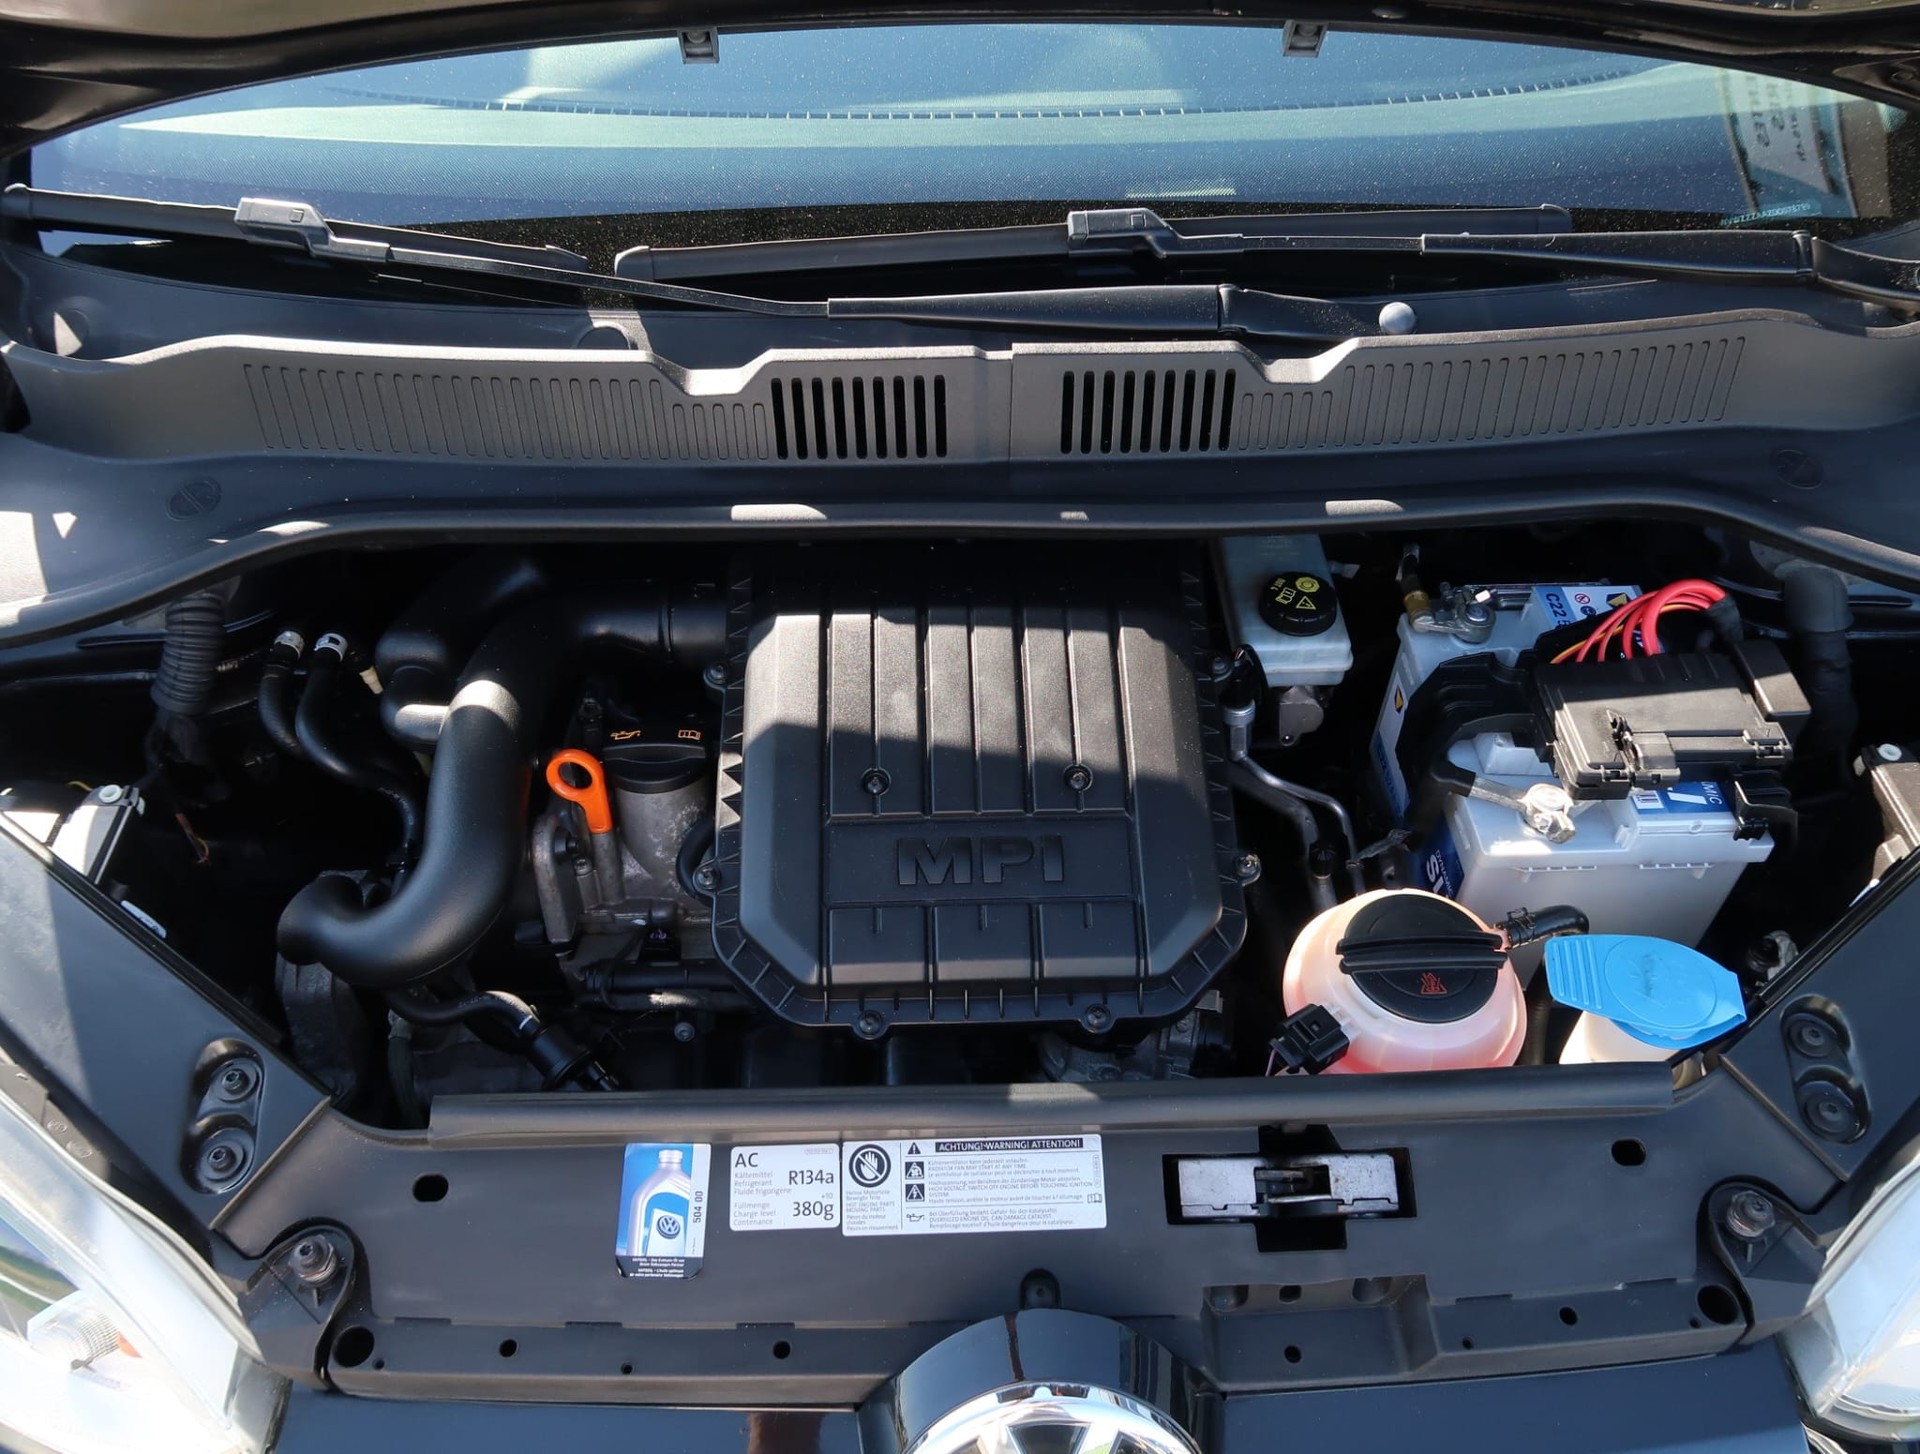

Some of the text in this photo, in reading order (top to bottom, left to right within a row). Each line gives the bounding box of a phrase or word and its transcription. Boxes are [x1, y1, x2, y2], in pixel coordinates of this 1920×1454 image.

[1546, 593, 1567, 617] C22
[1701, 781, 1723, 805] MIC
[897, 834, 1064, 885] MPI
[939, 1138, 1080, 1151] ACHTUNG! WARNING! ATTENTION!
[734, 1152, 759, 1168] AC
[788, 1169, 834, 1186] R134a
[692, 1191, 704, 1224] 504 00
[792, 1200, 834, 1221] 380g
